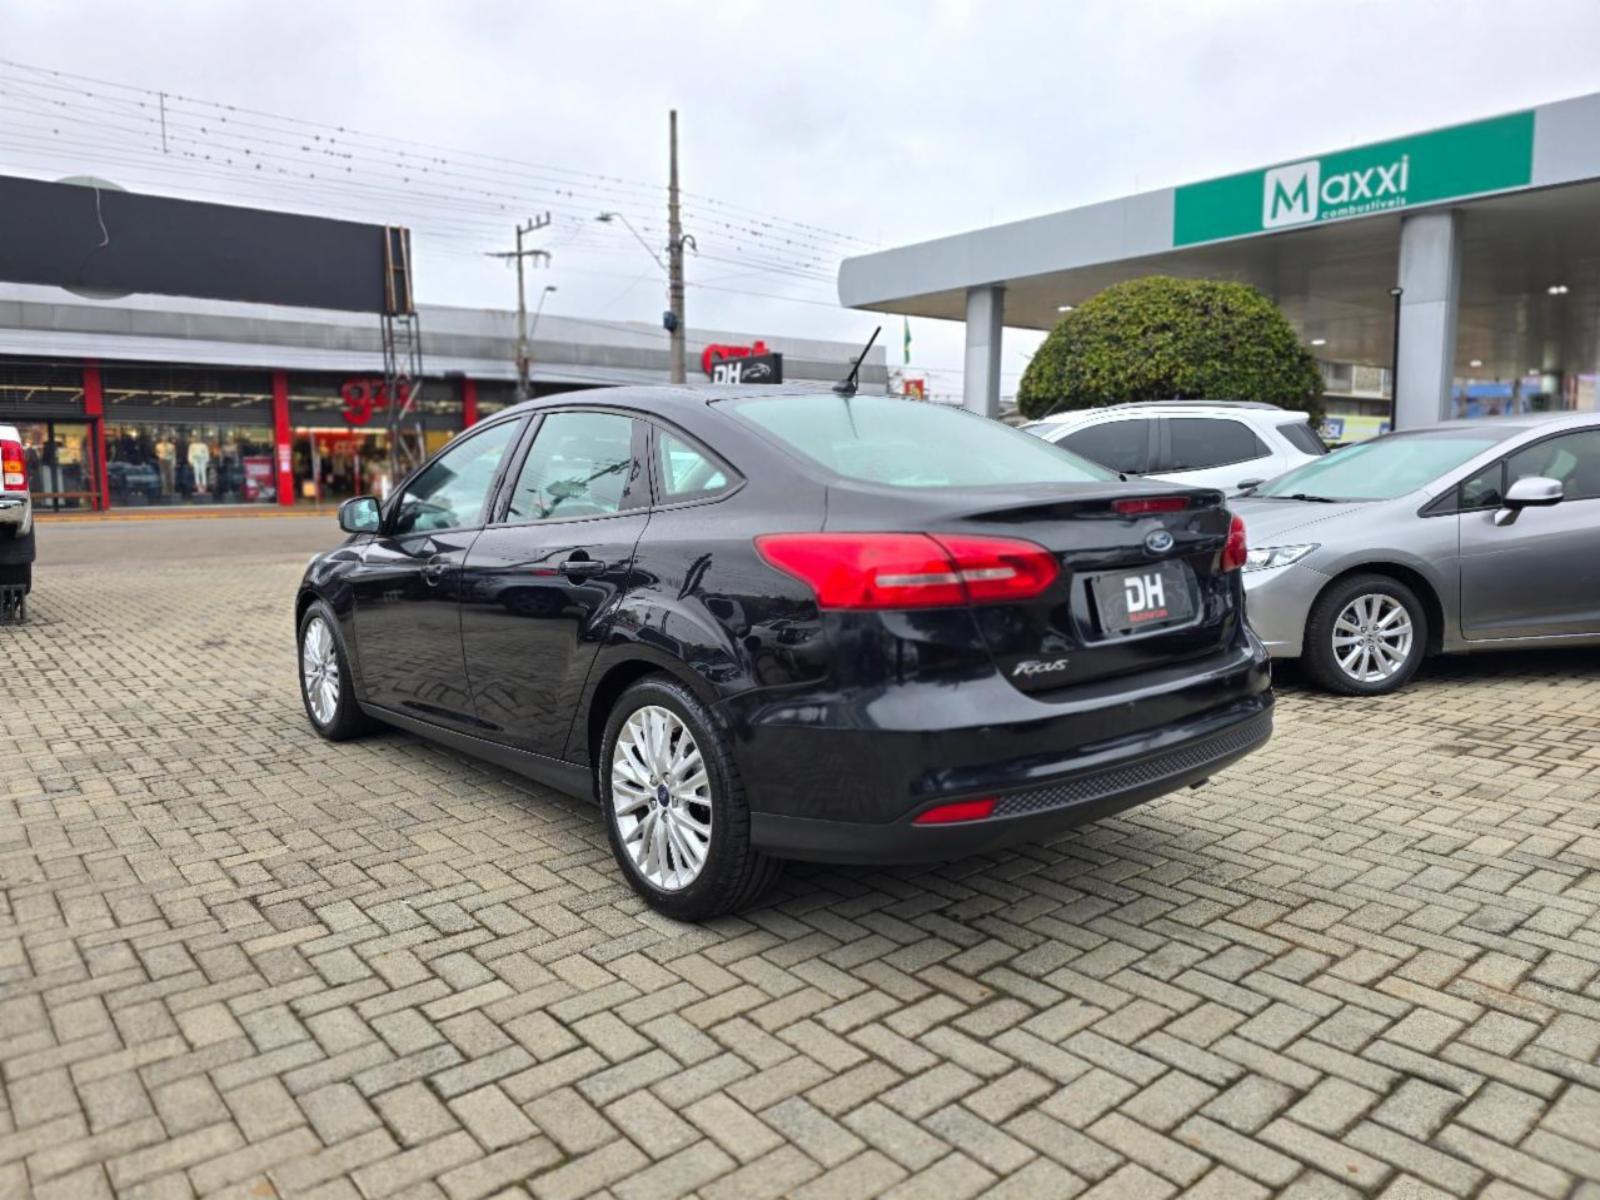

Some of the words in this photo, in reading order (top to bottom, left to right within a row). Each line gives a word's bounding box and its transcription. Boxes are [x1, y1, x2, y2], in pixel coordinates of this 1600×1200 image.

[1269, 154, 1410, 220] Maxxi
[713, 362, 741, 385] DH
[1124, 573, 1165, 613] DH
